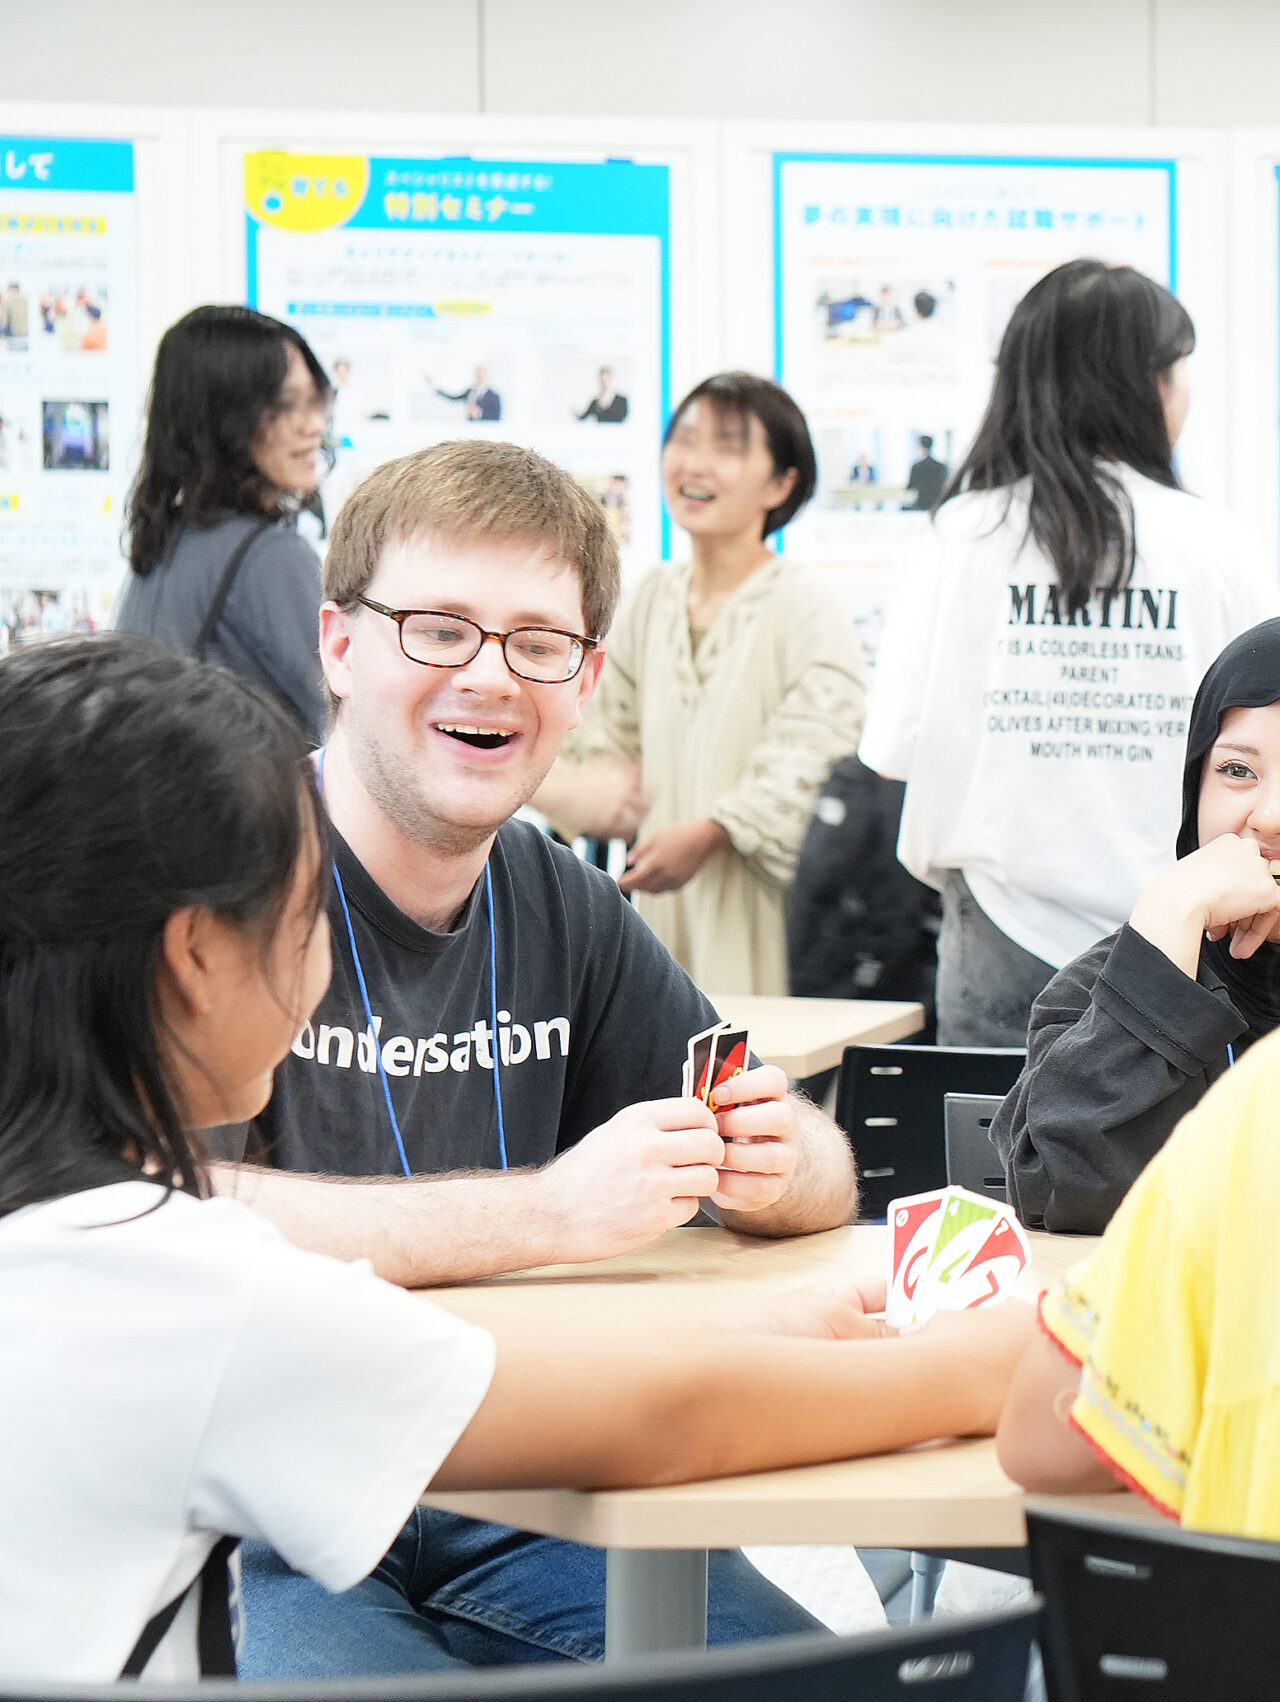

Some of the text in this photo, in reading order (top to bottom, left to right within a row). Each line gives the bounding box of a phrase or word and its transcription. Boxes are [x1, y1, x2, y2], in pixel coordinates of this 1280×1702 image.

[1025, 640, 1036, 656] A
[1039, 640, 1130, 660] COLORLESS
[1060, 665, 1119, 683] PARENT
[987, 715, 1042, 733] OLIVES
[1047, 717, 1093, 735] AFTER
[1097, 719, 1150, 737] MIXING
[1030, 742, 1154, 762] MOUTH WITH GIN
